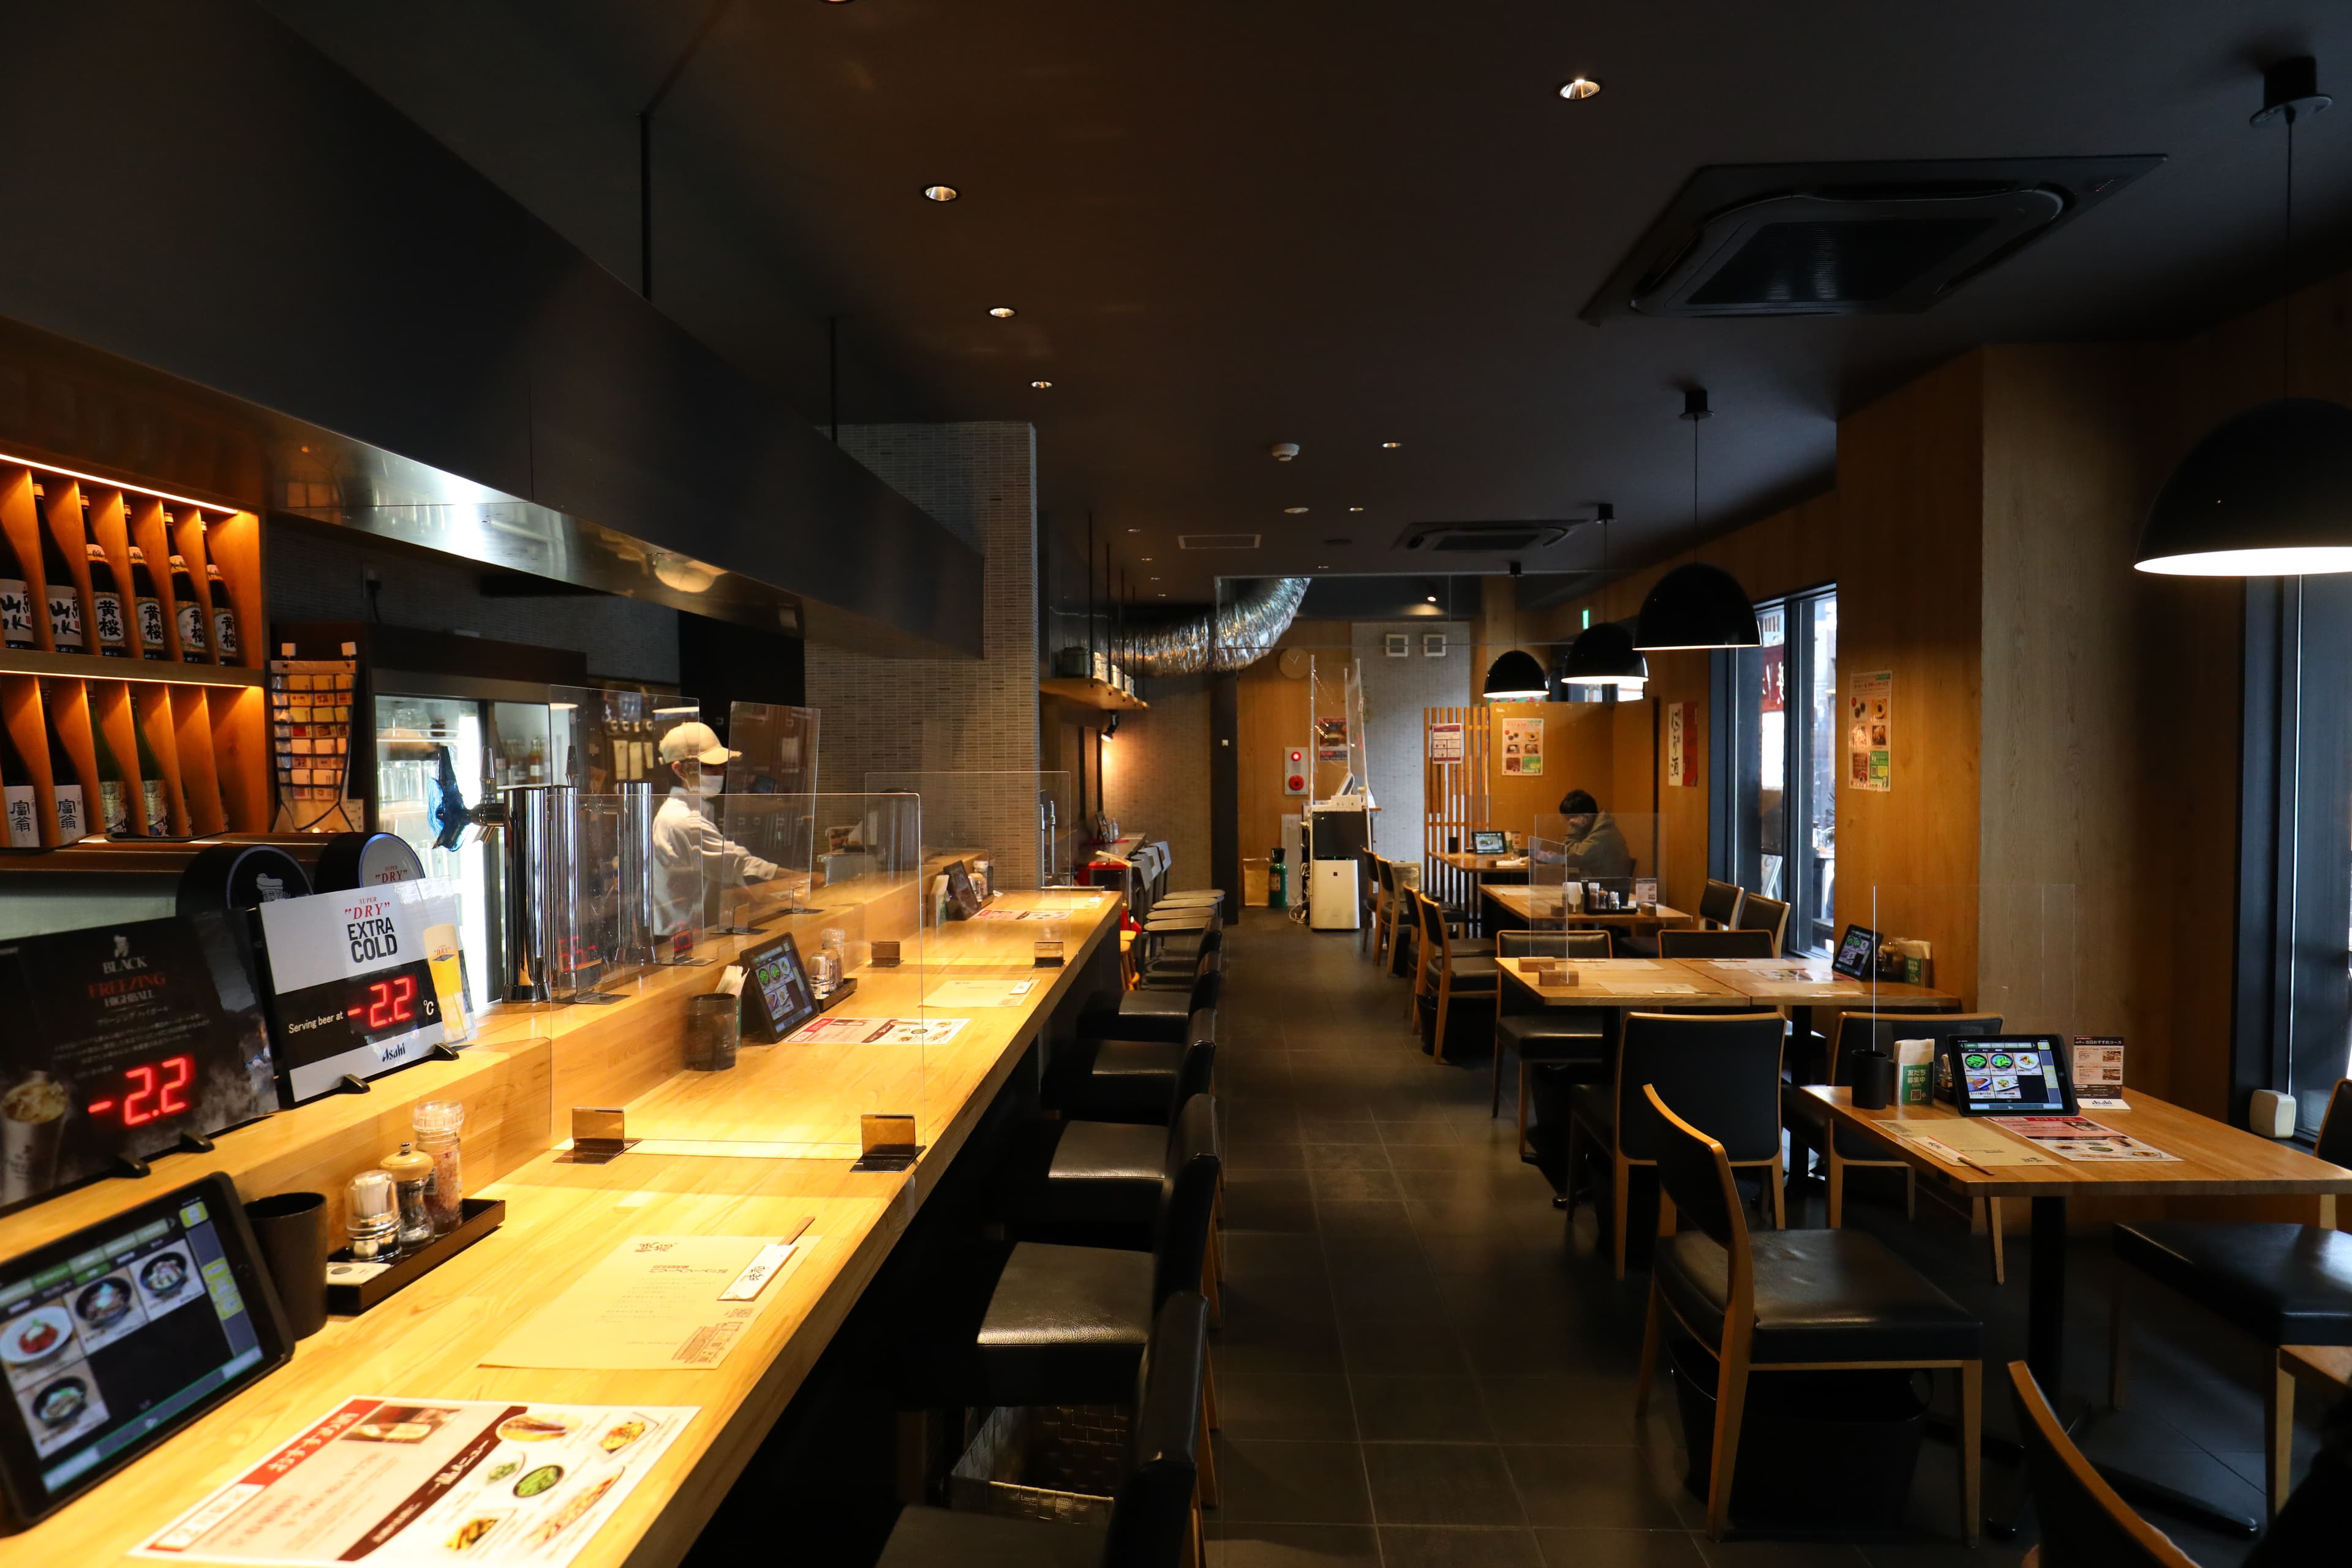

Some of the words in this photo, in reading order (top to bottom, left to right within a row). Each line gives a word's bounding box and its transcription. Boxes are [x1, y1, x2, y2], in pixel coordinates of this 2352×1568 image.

[0, 595, 32, 630] 山水
[49, 600, 81, 635] 山水
[96, 600, 121, 637] 黄桜
[144, 605, 163, 641] 黄桜
[190, 609, 205, 644] 黄桜
[221, 616, 236, 648] 黄桜
[9, 800, 31, 832] 富翁
[58, 799, 77, 830] 富翁
[359, 896, 377, 905] SUPER
[347, 916, 395, 941] EXTRA
[350, 933, 398, 964] COLD
[102, 956, 148, 974] BLACK
[88, 972, 167, 999] FREEZING
[104, 989, 156, 1008] HIGHBALL
[288, 1019, 317, 1035] Serving
[318, 1014, 335, 1025] beer
[336, 1011, 344, 1021] at
[347, 976, 413, 1028] -2.2
[382, 1042, 406, 1063] Asahi
[88, 1057, 187, 1126] -2.2
